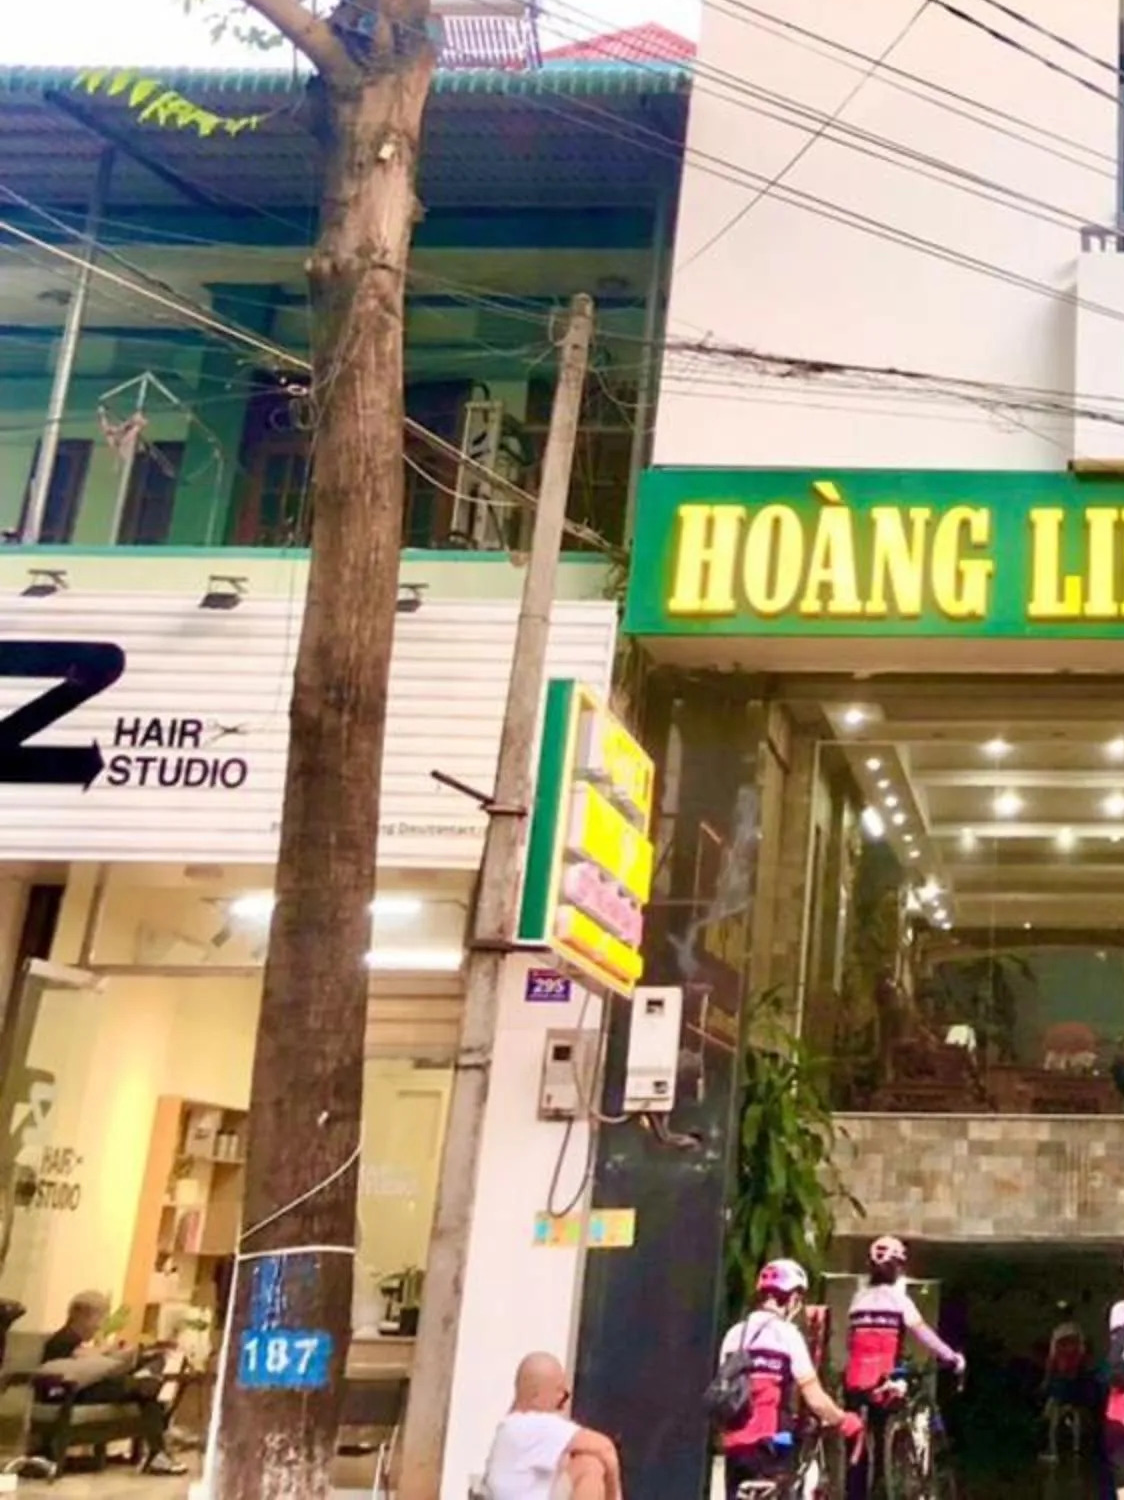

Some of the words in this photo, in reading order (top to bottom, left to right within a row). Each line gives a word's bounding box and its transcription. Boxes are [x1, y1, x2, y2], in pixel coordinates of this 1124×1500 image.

[668, 481, 994, 619] HOÀNG
[114, 717, 203, 749] HAIR
[107, 754, 248, 789] STUDIO
[244, 1337, 319, 1375] 187
